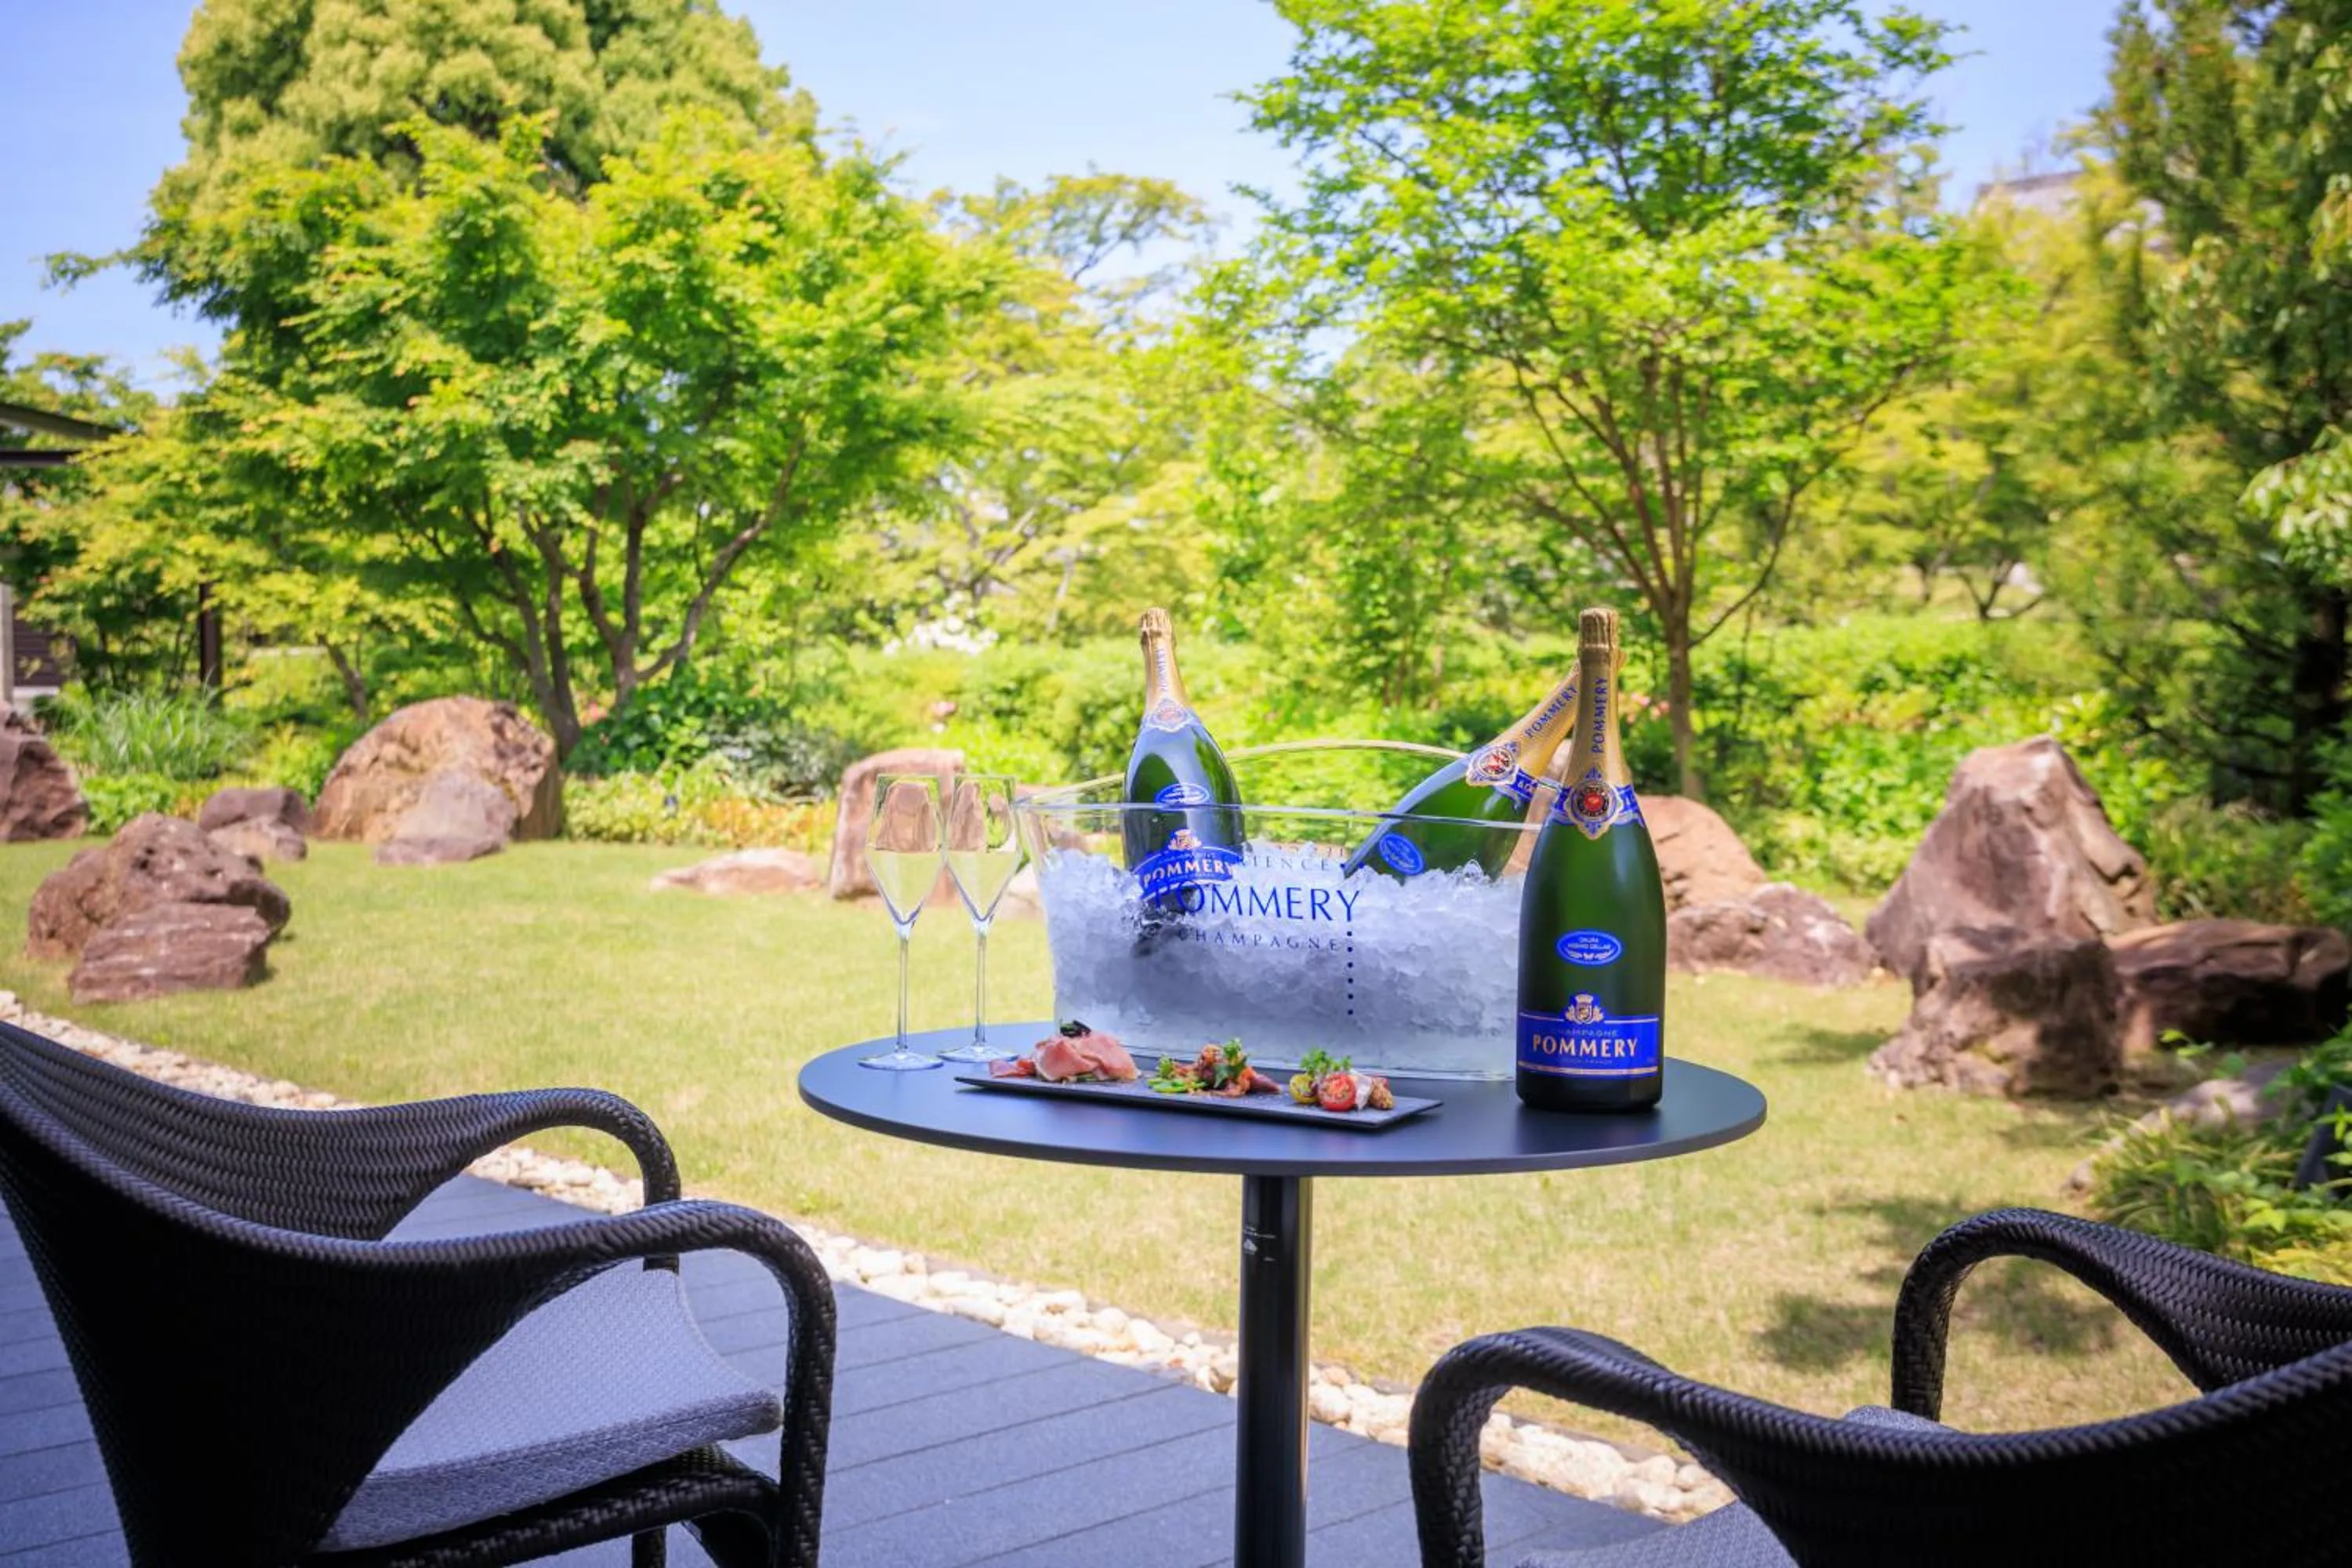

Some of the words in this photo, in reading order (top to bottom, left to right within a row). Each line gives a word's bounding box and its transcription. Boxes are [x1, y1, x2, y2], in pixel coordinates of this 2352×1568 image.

[1525, 684, 1578, 739] POMMERY
[1592, 677, 1608, 753] POMMERY
[1533, 1033, 1638, 1058] POMMERY
